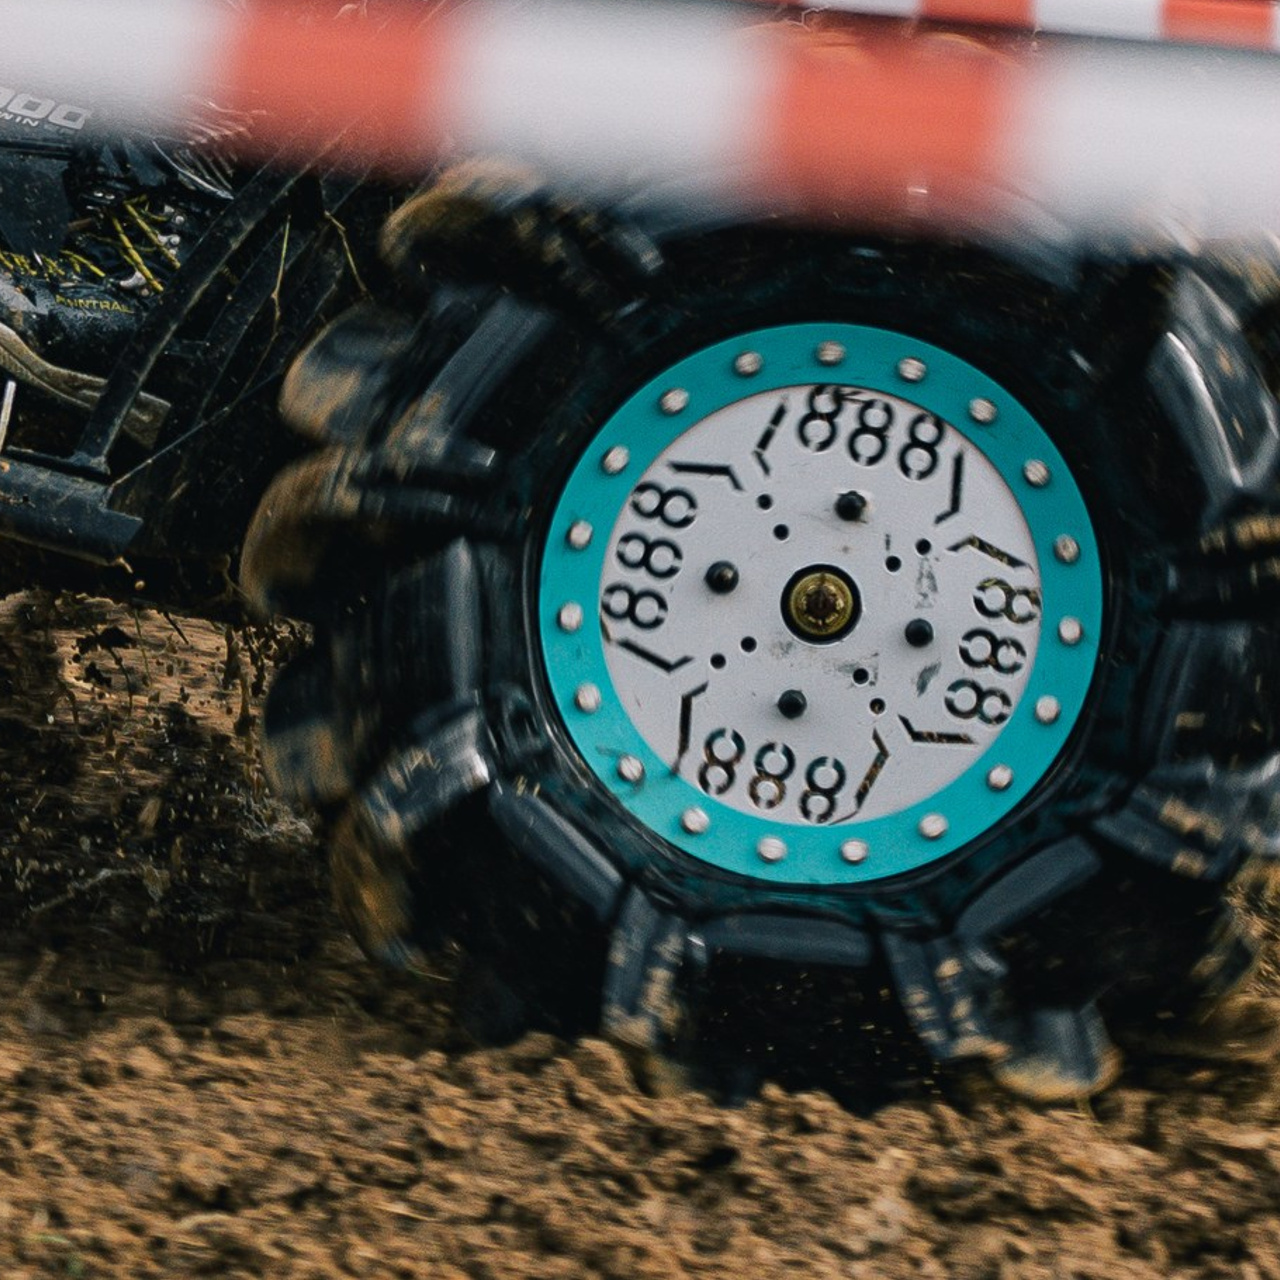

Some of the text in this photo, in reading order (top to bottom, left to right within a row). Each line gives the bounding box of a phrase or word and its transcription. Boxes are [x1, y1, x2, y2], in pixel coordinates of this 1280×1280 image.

[601, 479, 699, 632] 888
[944, 578, 1041, 727] 888
[698, 726, 847, 825] 888
